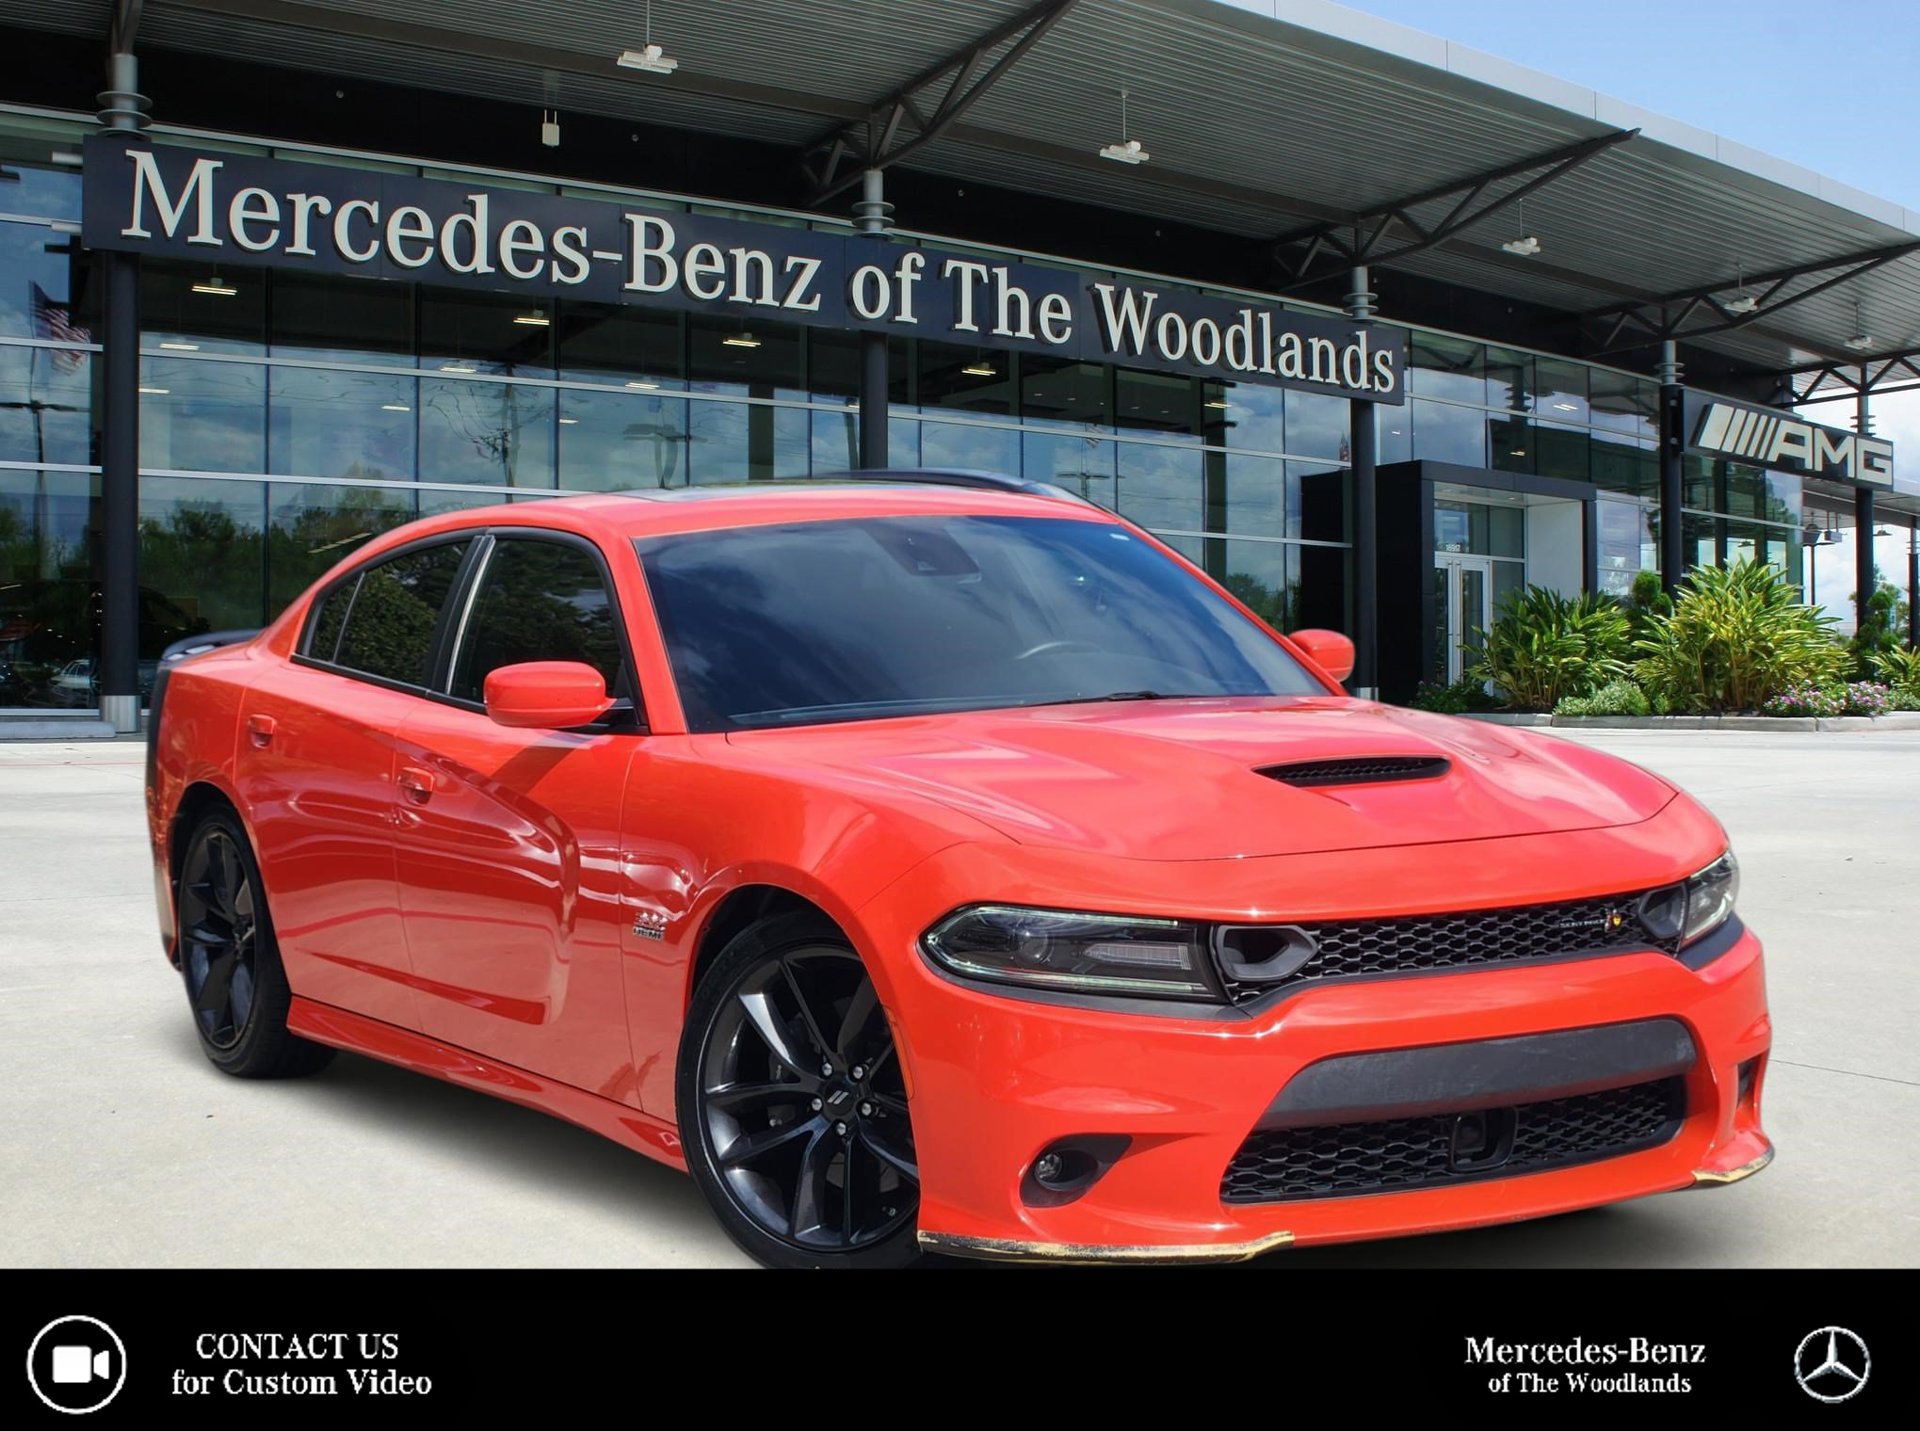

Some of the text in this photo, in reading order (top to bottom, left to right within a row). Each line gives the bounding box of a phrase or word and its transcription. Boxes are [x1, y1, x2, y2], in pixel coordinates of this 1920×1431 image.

[121, 149, 1394, 394] Mercedes-Benz of The Woodlands
[1766, 418, 1894, 487] AMG
